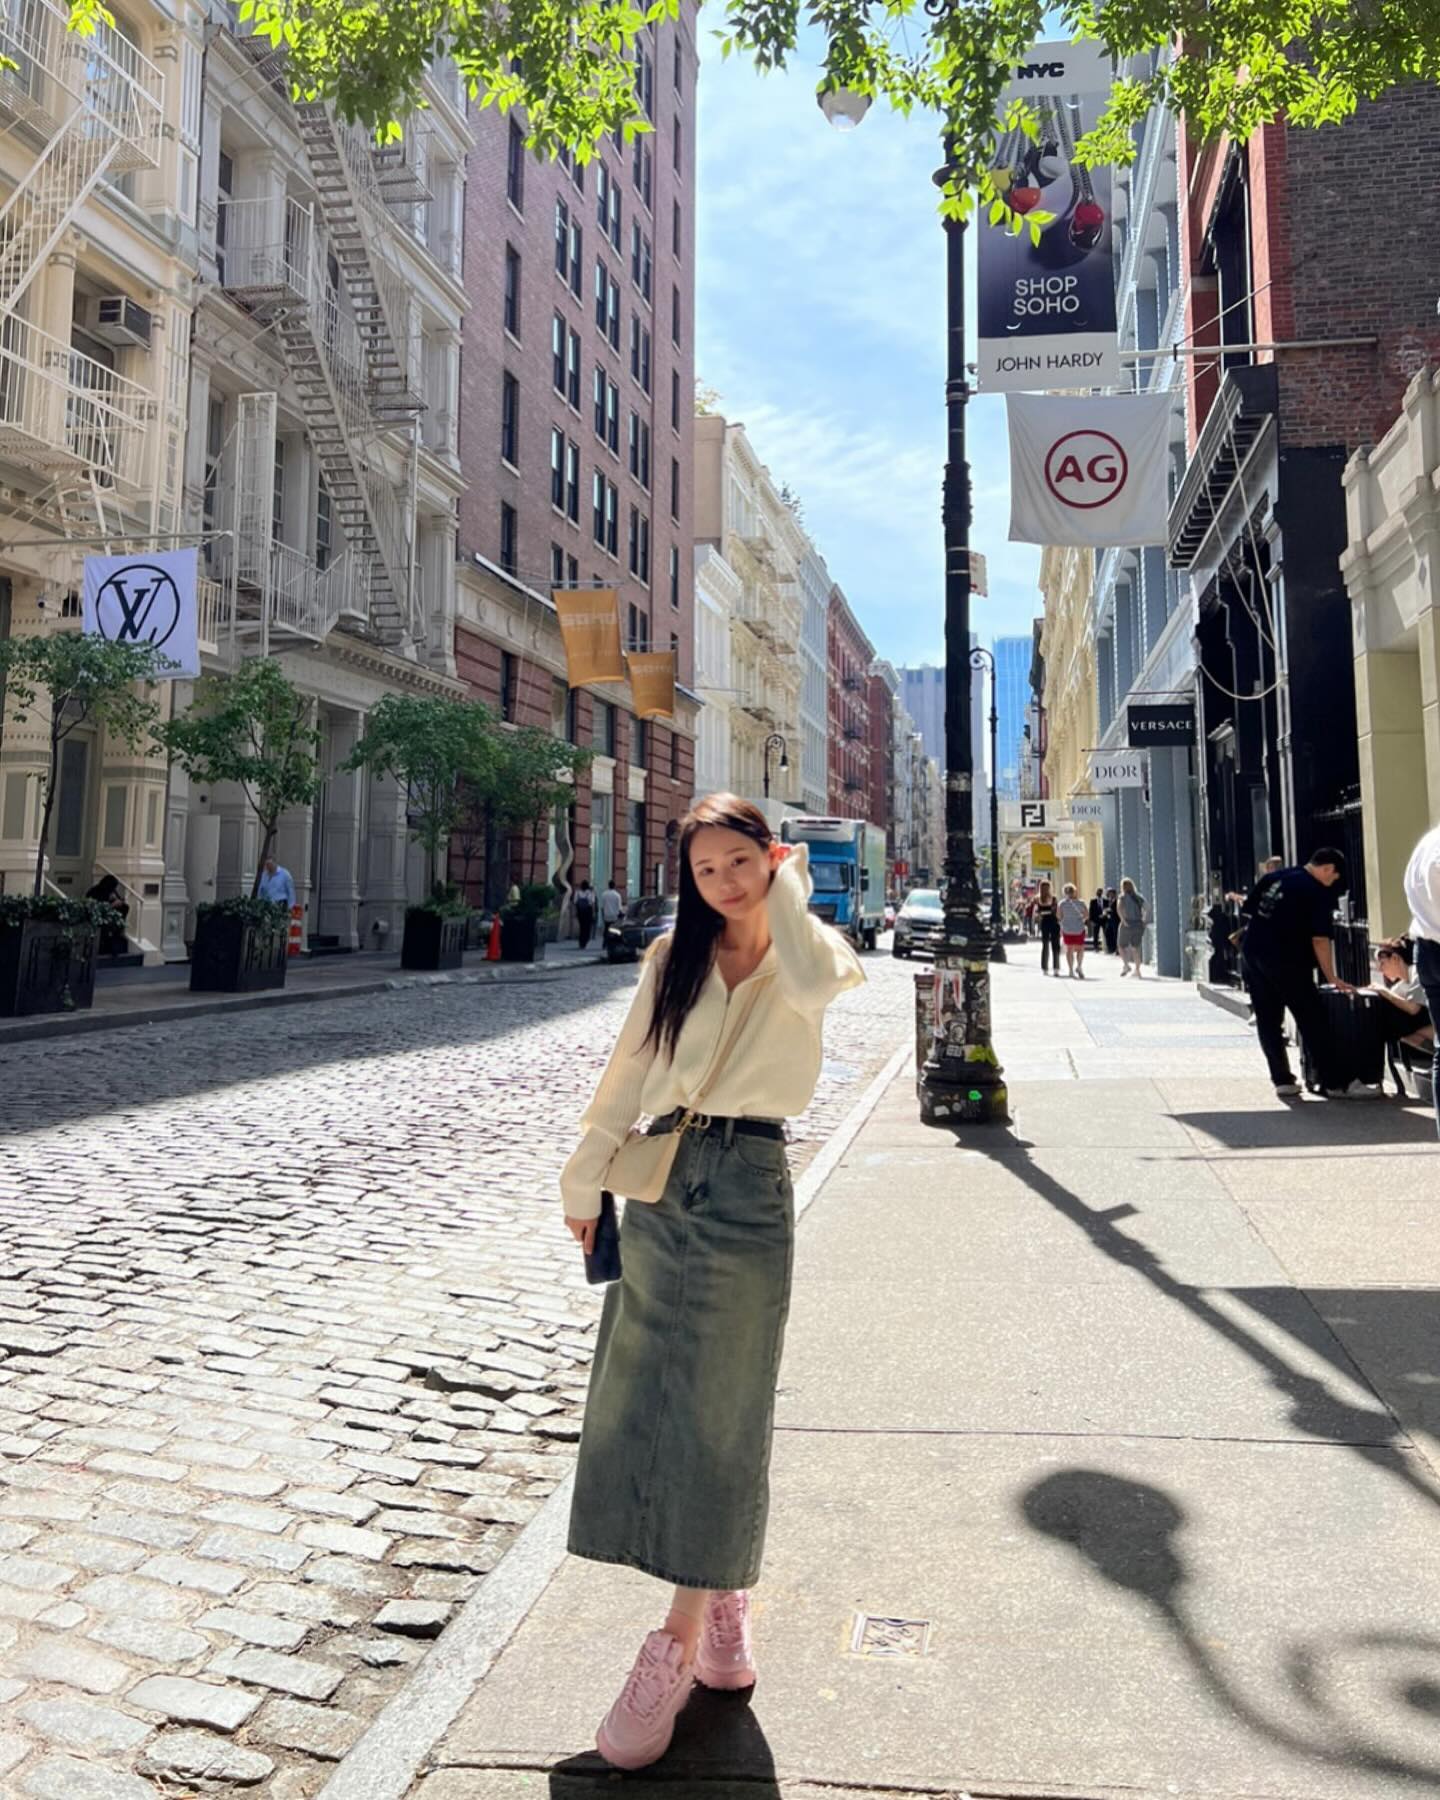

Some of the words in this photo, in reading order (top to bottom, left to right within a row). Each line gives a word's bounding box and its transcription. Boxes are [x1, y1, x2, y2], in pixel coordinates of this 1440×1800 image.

[1017, 62, 1064, 79] NYC
[1015, 276, 1078, 296] SHOP
[1013, 295, 1080, 315] SOHO
[996, 356, 1041, 373] JOHN
[1047, 352, 1103, 369] HARDY
[1055, 454, 1117, 483] AG
[1131, 720, 1192, 731] VERSACE
[1095, 765, 1137, 779] DIOR
[1072, 804, 1102, 816] DIOR
